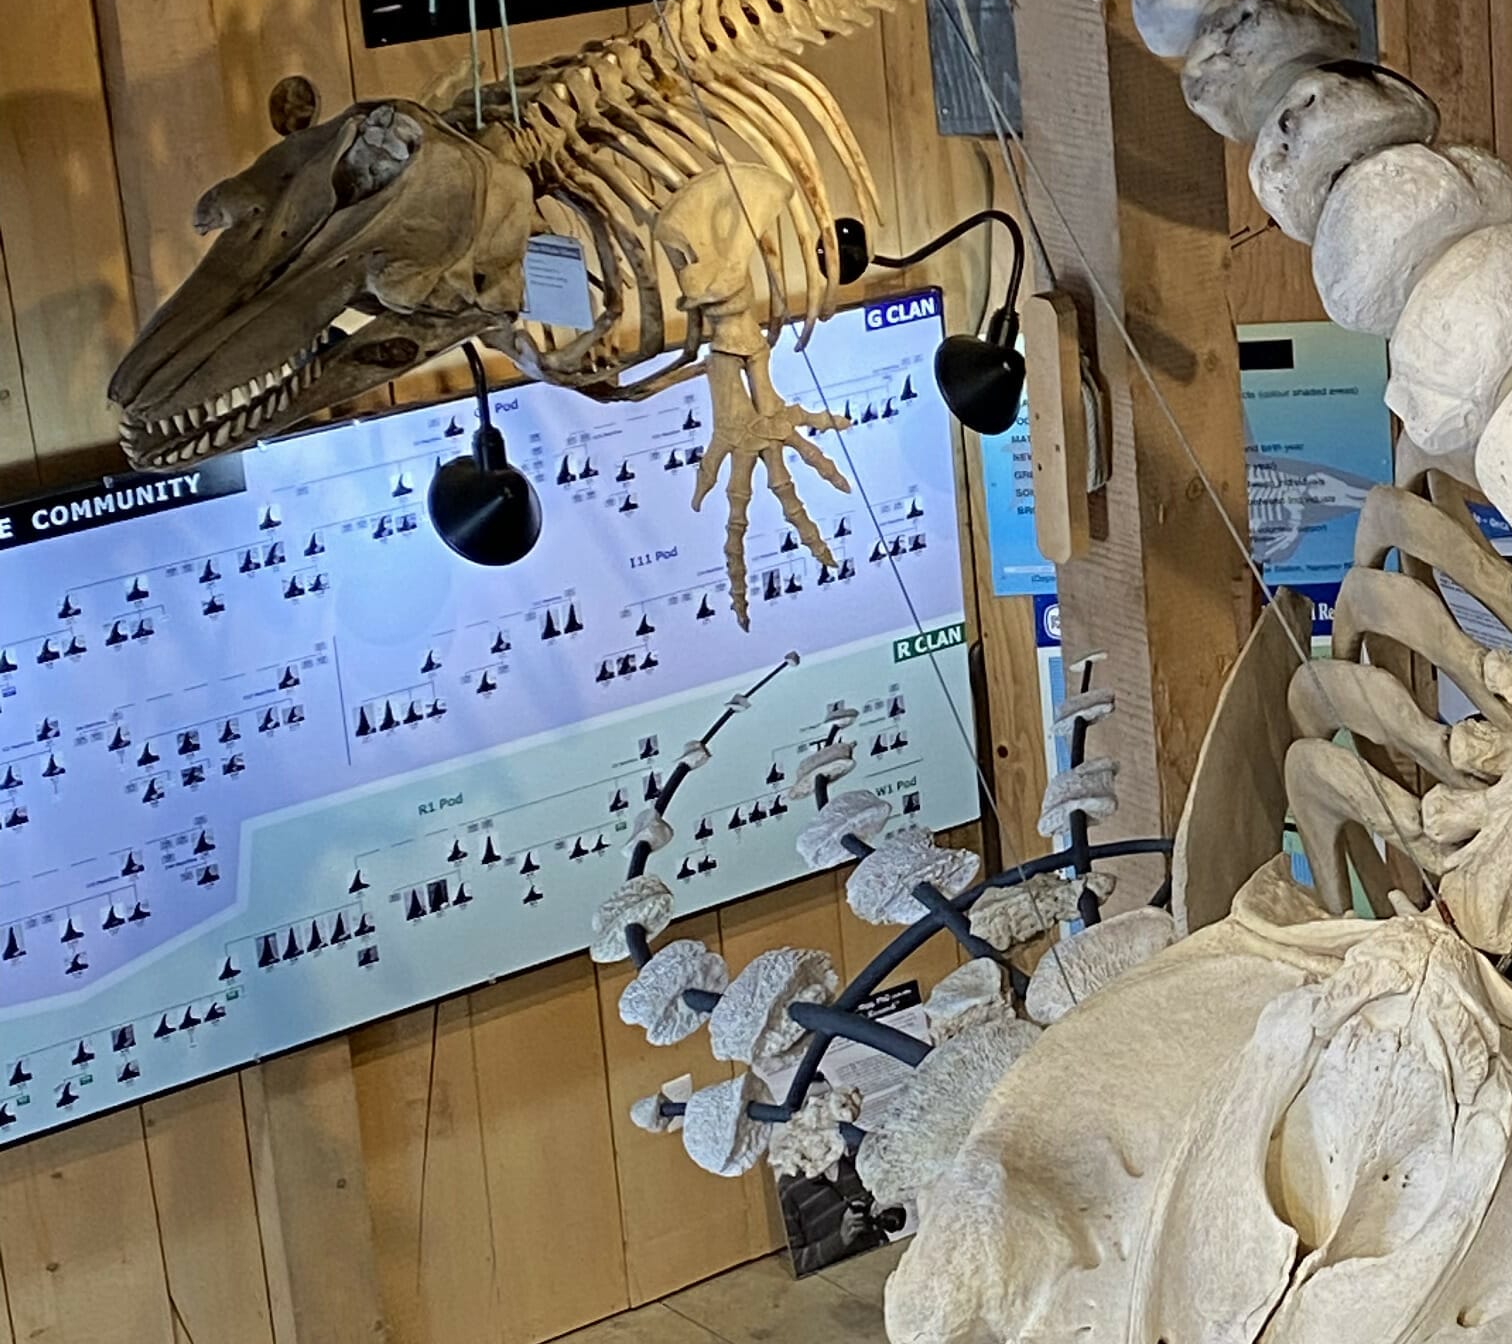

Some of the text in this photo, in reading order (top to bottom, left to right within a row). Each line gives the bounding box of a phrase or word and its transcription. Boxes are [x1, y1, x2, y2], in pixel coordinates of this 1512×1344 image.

[867, 296, 935, 328] G CLAN
[495, 398, 519, 414] Pod
[31, 472, 201, 530] COMMUNITY
[655, 545, 678, 561] Pod
[896, 625, 962, 659] R CLAN
[897, 776, 917, 790] Pod
[418, 792, 463, 817] R1 Pod
